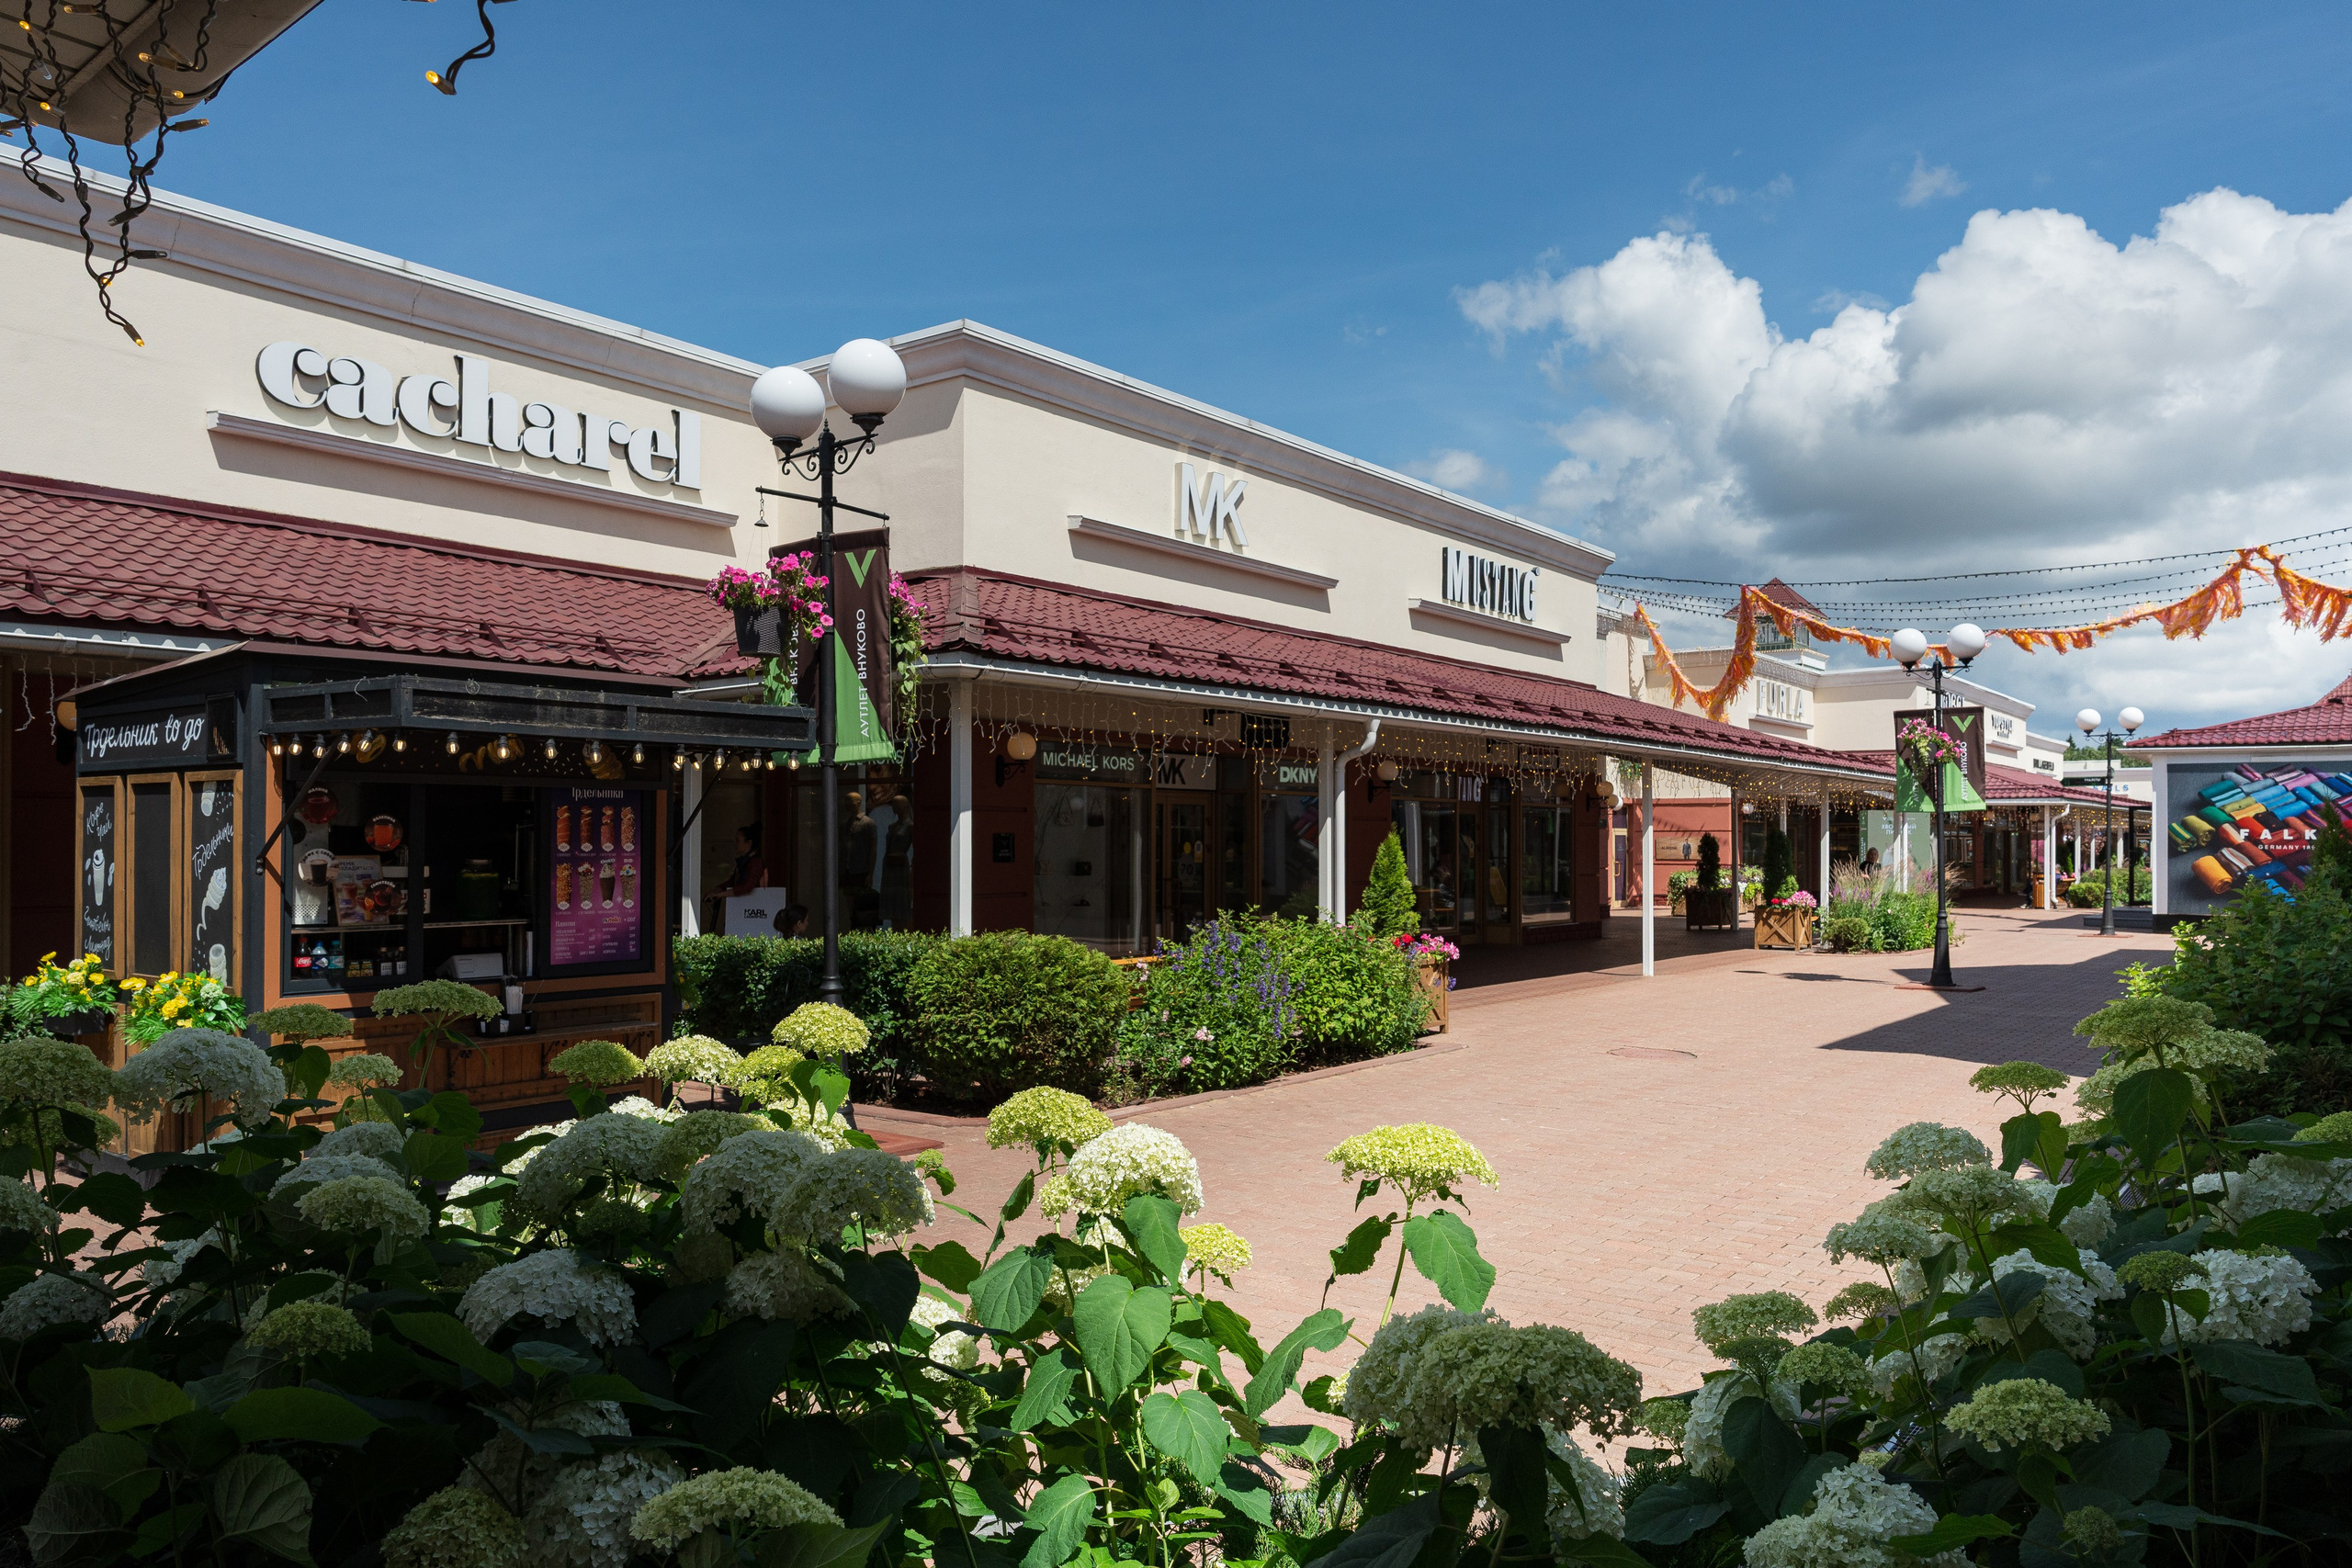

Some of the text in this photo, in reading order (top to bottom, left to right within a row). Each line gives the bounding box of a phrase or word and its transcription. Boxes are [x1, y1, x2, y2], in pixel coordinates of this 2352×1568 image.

[255, 341, 702, 491] cacharel
[1175, 462, 1249, 547] MK
[856, 608, 870, 738] АУТЛЕТ ВНУКОВО
[1757, 680, 1804, 717] FURLA
[85, 714, 205, 758] Трдельник to go
[1043, 751, 1135, 772] MICHAEL KORS
[1279, 765, 1318, 784] DKNY
[86, 802, 104, 835] Кофе
[96, 813, 112, 841] Чай
[2239, 829, 2317, 840] FALK
[192, 822, 234, 880] Трдельники
